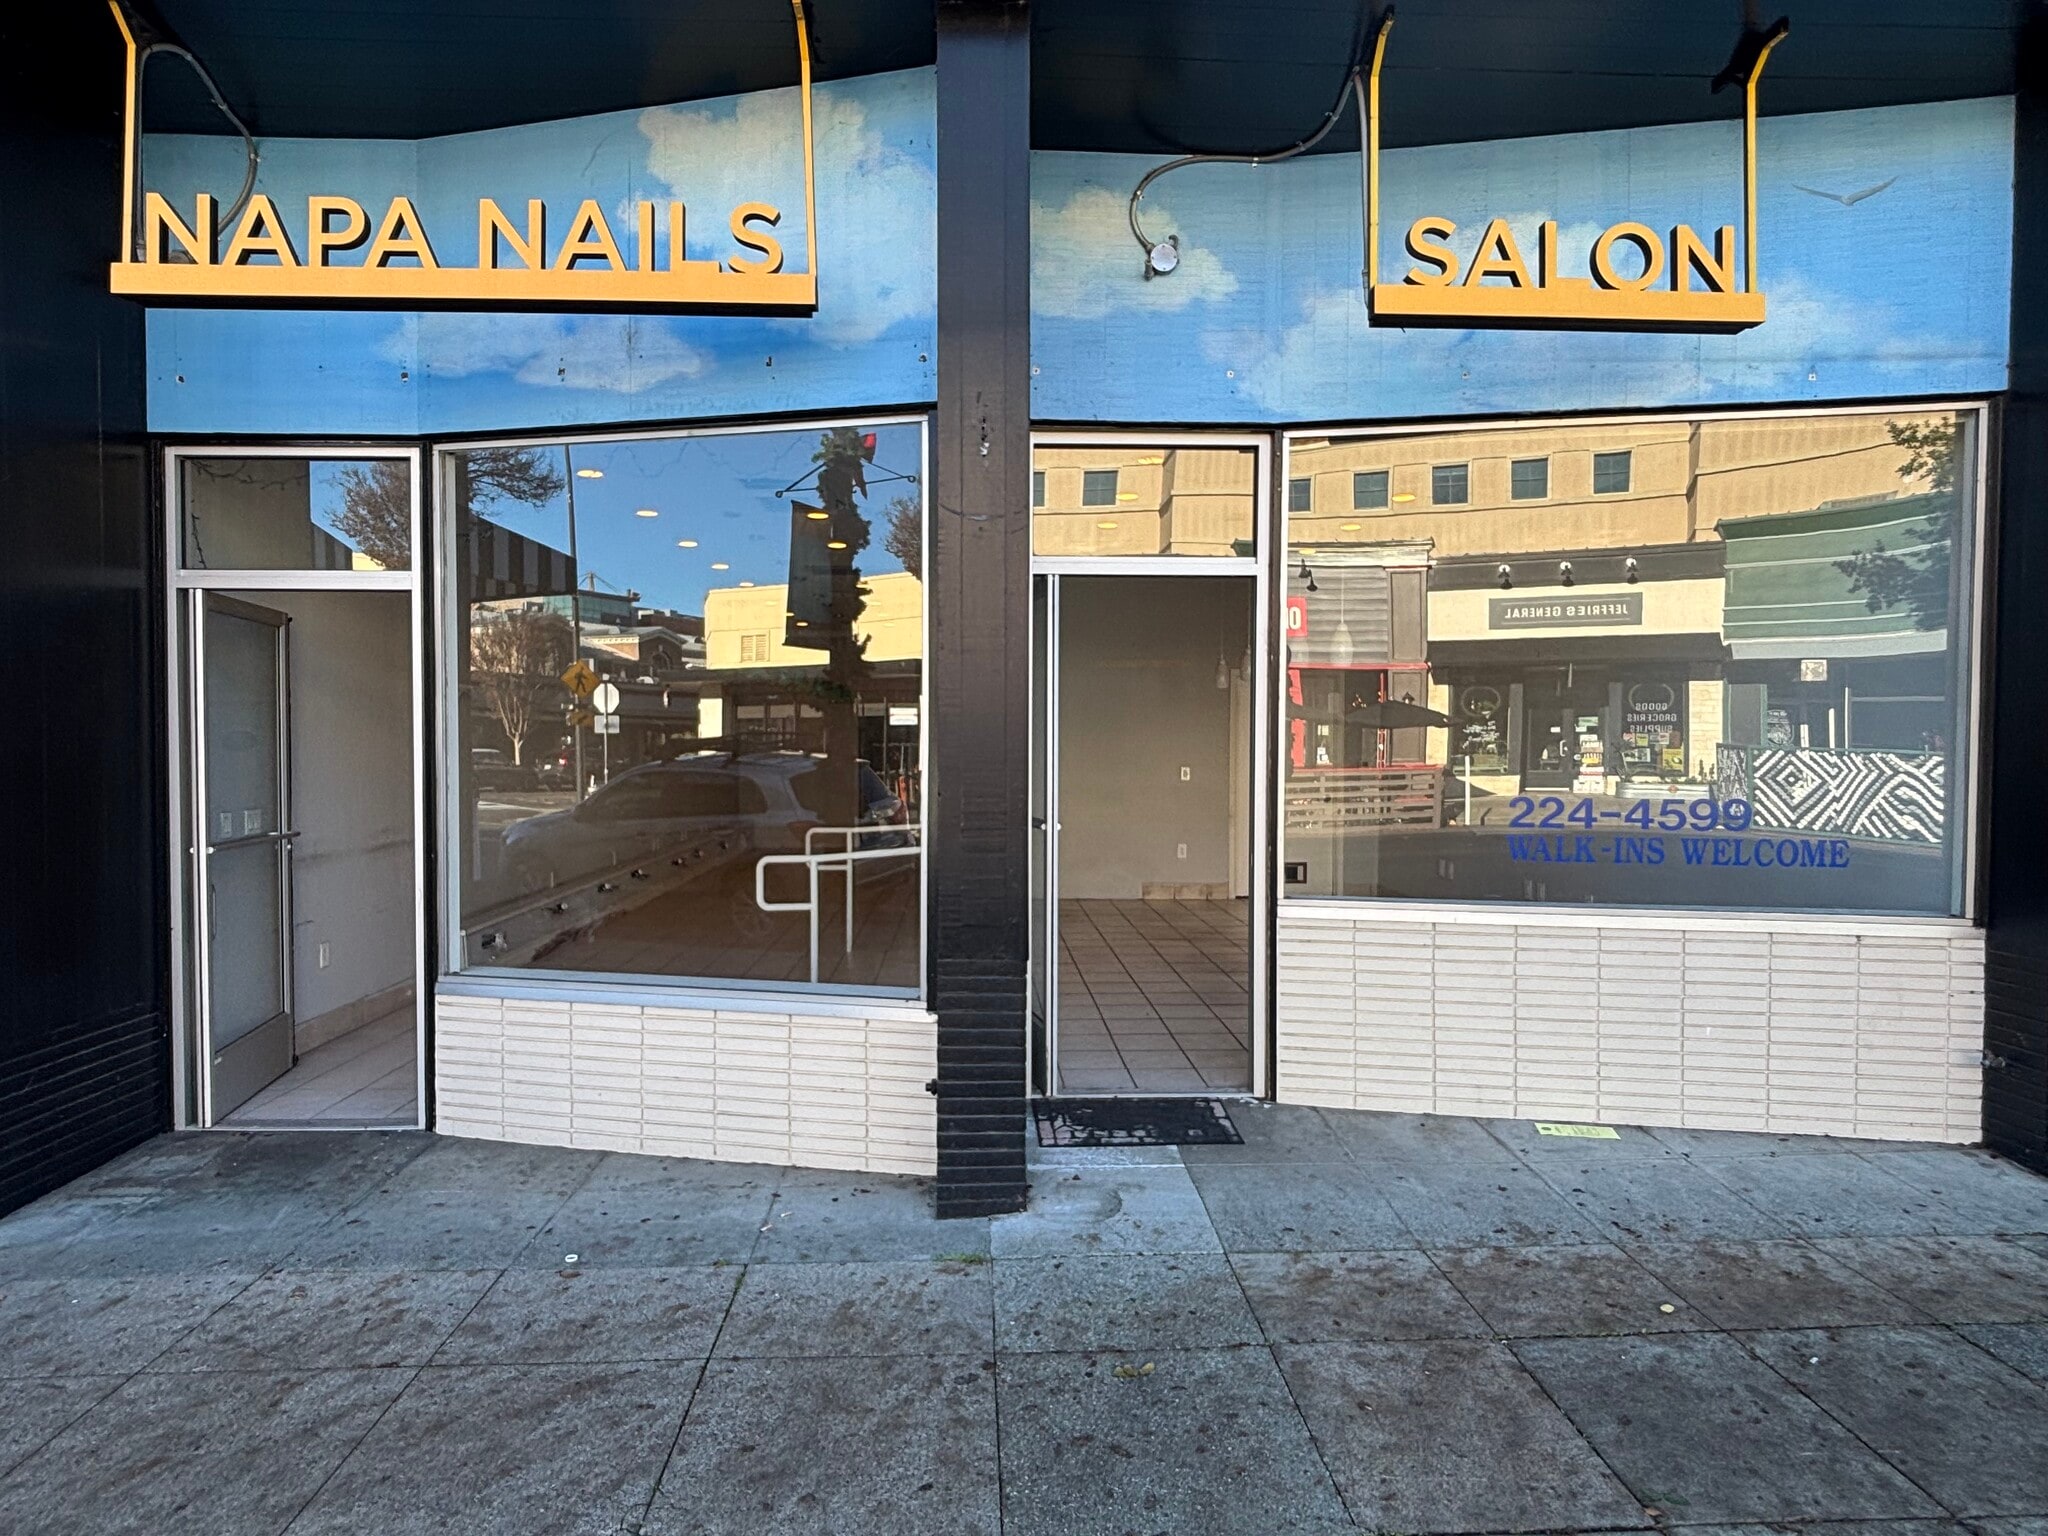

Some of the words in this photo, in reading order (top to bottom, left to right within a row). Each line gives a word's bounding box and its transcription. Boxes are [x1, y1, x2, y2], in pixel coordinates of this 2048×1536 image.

[145, 192, 442, 268] NAPA
[478, 198, 784, 273] NAILS
[1403, 216, 1735, 293] SALON
[1508, 796, 1752, 832] 224-4599
[1506, 835, 1665, 865] WALK-INS
[1682, 838, 1851, 868] WELCOME
